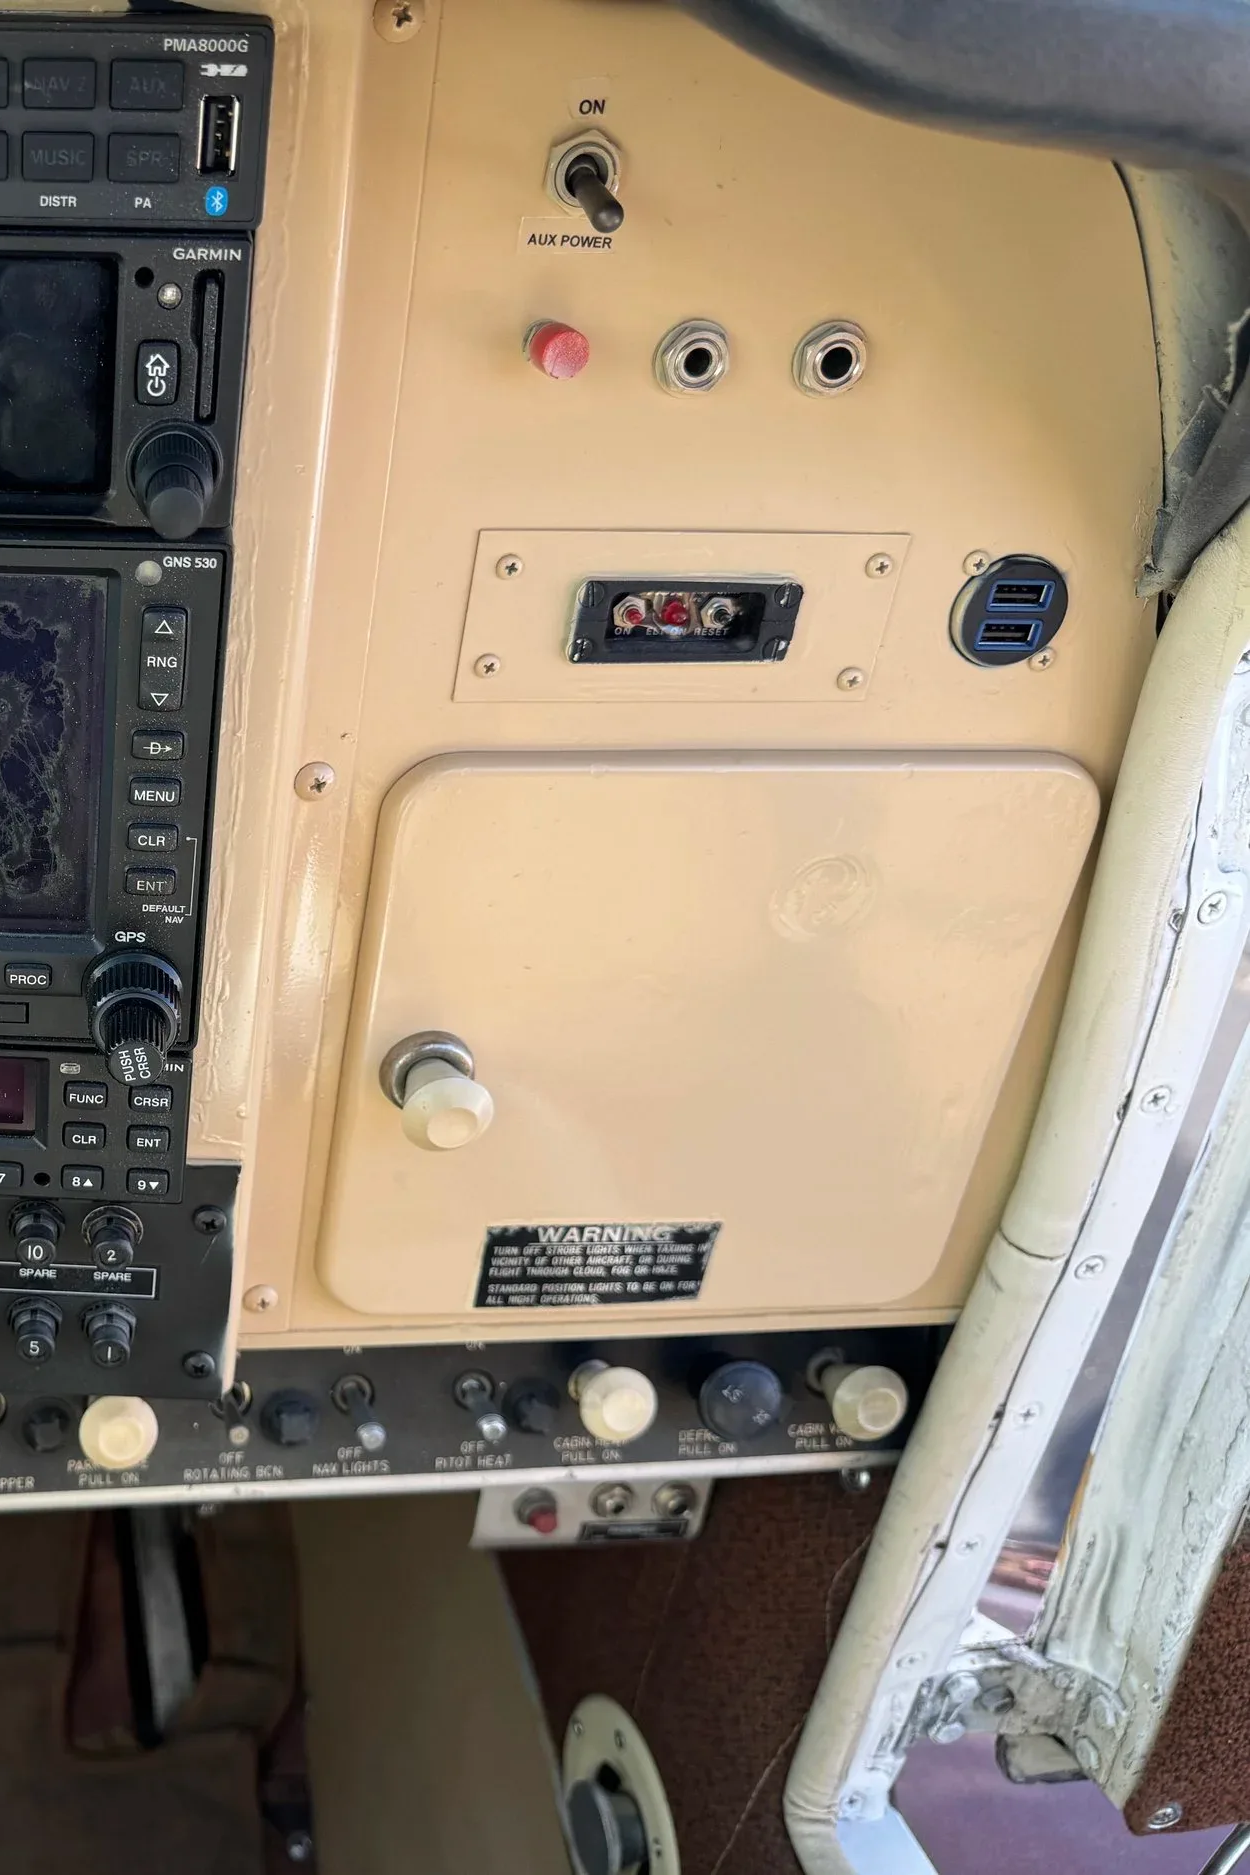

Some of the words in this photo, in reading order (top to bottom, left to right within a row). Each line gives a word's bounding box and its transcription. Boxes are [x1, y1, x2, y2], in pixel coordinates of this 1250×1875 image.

[163, 38, 249, 54] PMA8000G
[579, 99, 606, 115] ON
[40, 195, 77, 208] DISTR
[134, 197, 152, 210] PA
[527, 234, 557, 246] AUX
[560, 235, 612, 249] POWER
[173, 248, 242, 261] GARMIN
[163, 557, 191, 568] GNS
[194, 558, 217, 569] 530
[694, 628, 730, 637] RESET
[147, 657, 177, 668] RNG
[134, 790, 175, 802] MENU
[137, 835, 166, 847] CLR
[136, 880, 164, 892] ENT
[142, 904, 186, 914] DEFAULT
[165, 915, 184, 924] NAV
[115, 931, 146, 943] GPS
[9, 974, 47, 986] PROC
[118, 1050, 136, 1081] PUSH
[134, 1047, 151, 1079] CRSR
[69, 1093, 104, 1105] FUNC
[134, 1096, 168, 1107] CRSR
[72, 1134, 97, 1145] CLR
[136, 1137, 161, 1148] ENT
[537, 1225, 672, 1242] WARNING
[27, 1245, 44, 1260] 10
[19, 1268, 57, 1278] SPARE
[94, 1271, 132, 1282] SPARE
[795, 1437, 830, 1449] PULL
[678, 1443, 711, 1456] PULL
[219, 1451, 245, 1465] OFF
[435, 1456, 471, 1470] PITOT
[478, 1454, 513, 1468] HEAT
[561, 1450, 595, 1463] PULL
[342, 1459, 390, 1473] LIGHTS
[79, 1473, 113, 1486] PULL
[121, 1473, 139, 1486] ON
[184, 1466, 250, 1481] ROTATING
